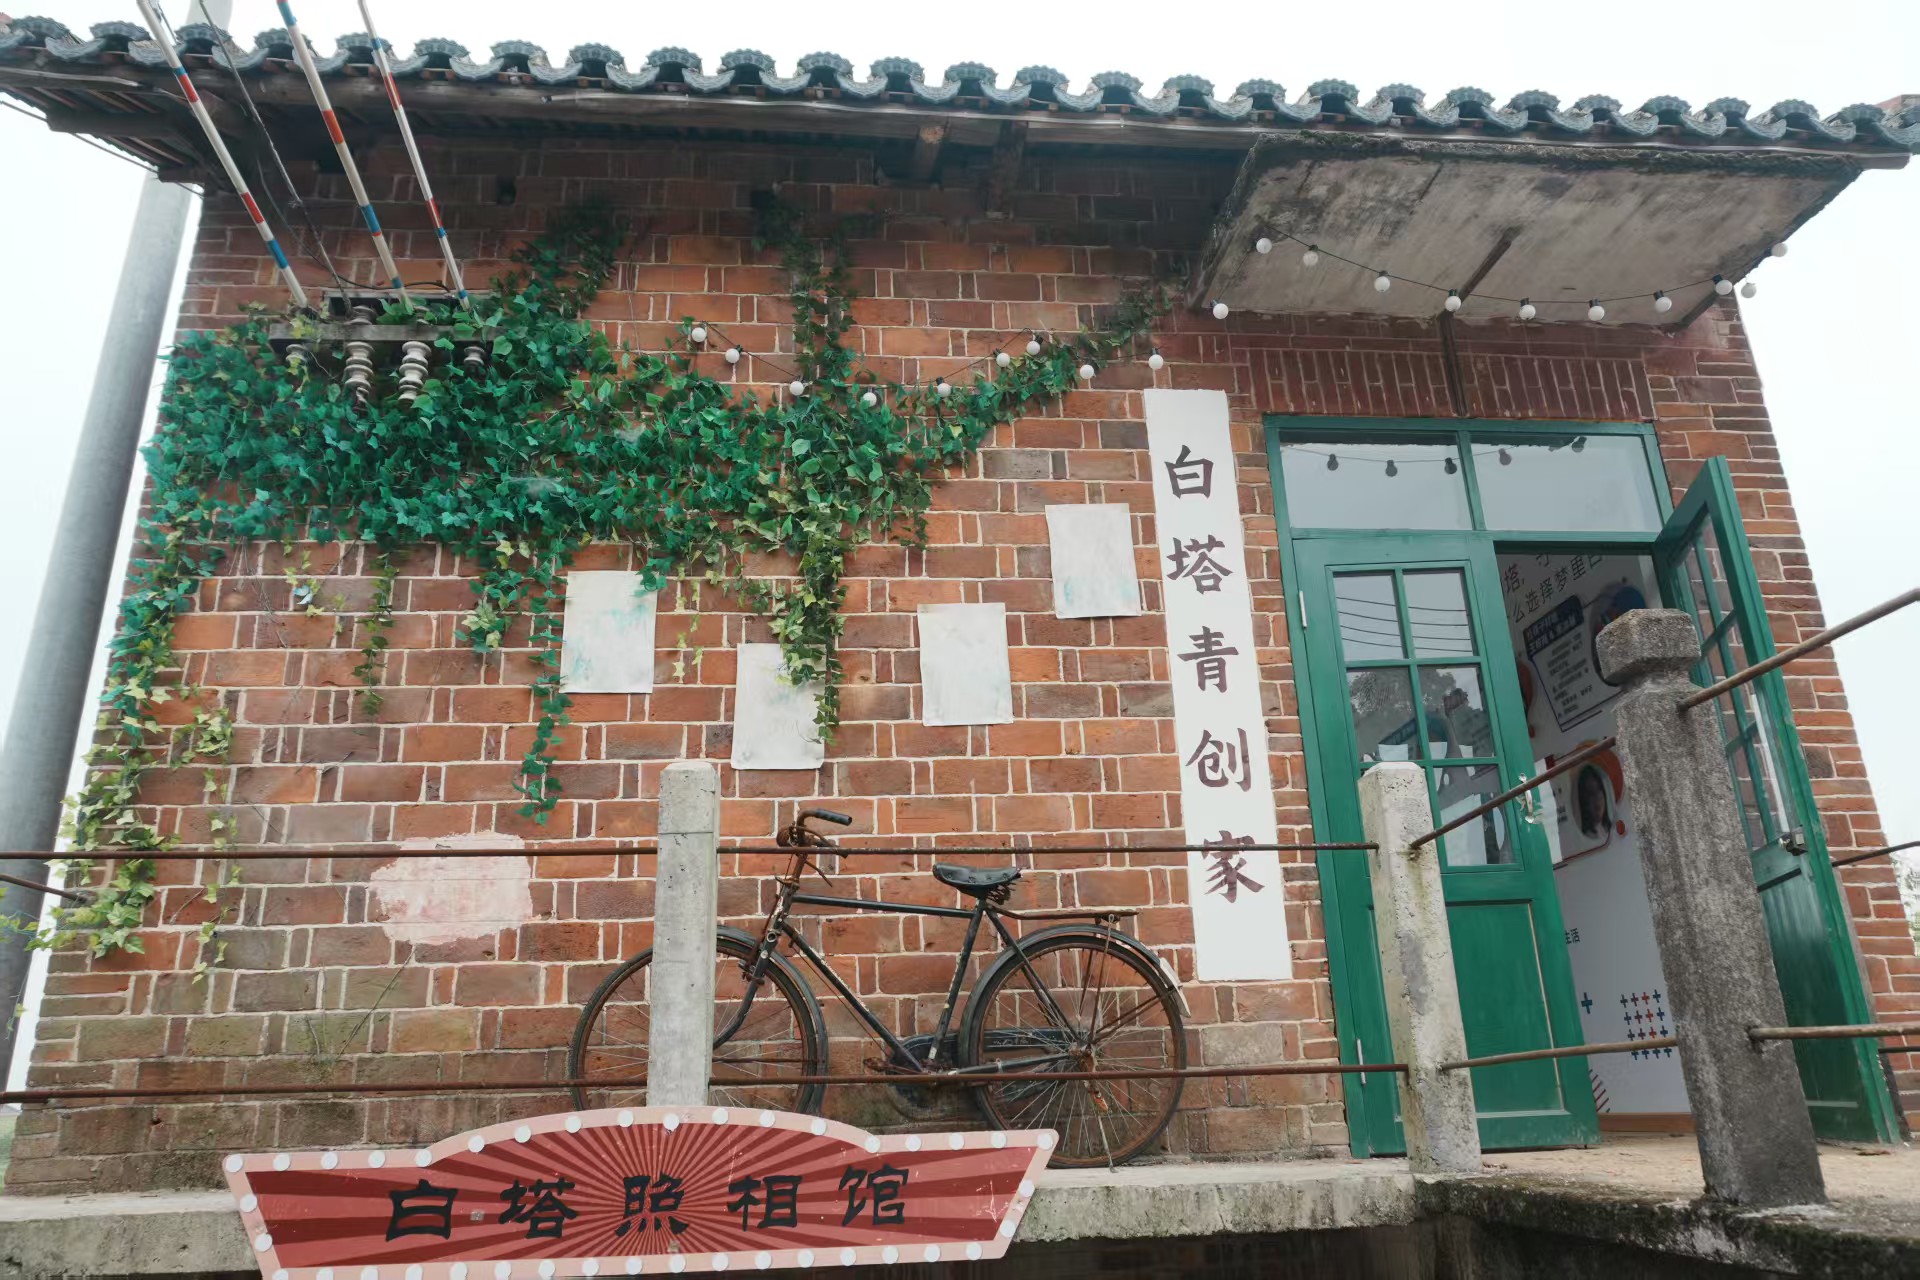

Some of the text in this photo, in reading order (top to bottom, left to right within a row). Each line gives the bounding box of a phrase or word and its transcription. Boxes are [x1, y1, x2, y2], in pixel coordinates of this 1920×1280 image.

[1164, 444, 1266, 904] 白塔青创家
[386, 1164, 911, 1242] 白塔照相馆
